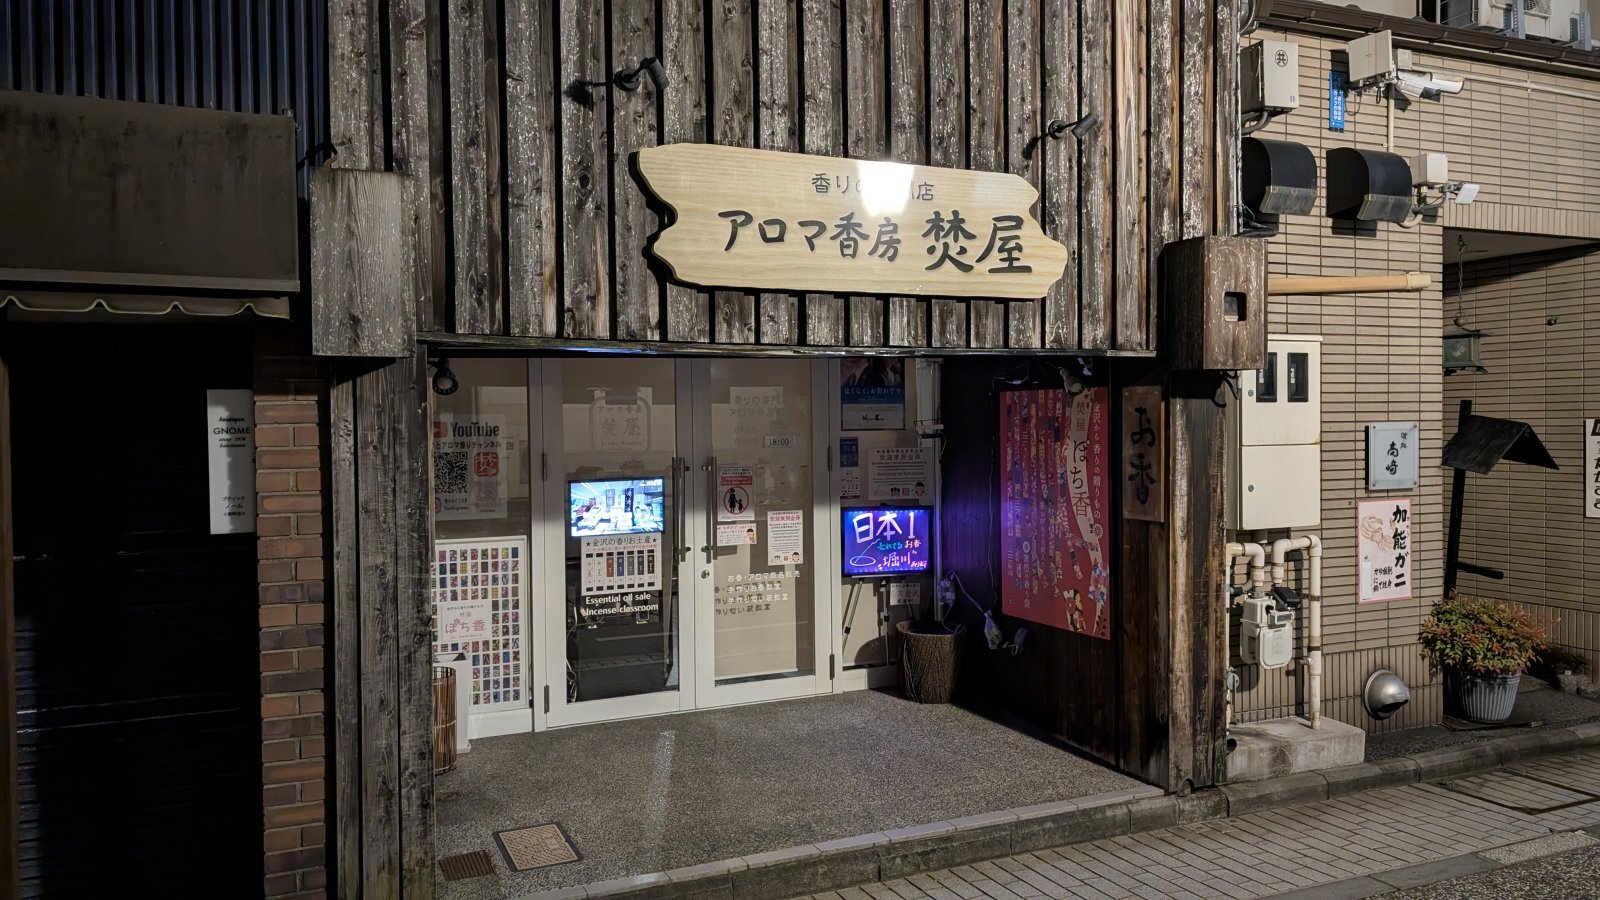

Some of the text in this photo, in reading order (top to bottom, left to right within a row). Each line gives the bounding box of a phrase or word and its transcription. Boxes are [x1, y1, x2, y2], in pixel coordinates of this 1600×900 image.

[811, 172, 934, 201] 香り店
[717, 209, 1033, 274] アロマ香房 焚屋
[213, 427, 251, 435] GNOME
[451, 422, 499, 437] YouTube
[769, 438, 790, 447] 18:00
[1071, 438, 1090, 518] ぽち香
[1392, 504, 1409, 589] 加能ガニ
[586, 595, 621, 605] Essential
[635, 592, 651, 601] sale
[587, 604, 659, 616] Incense classroom
